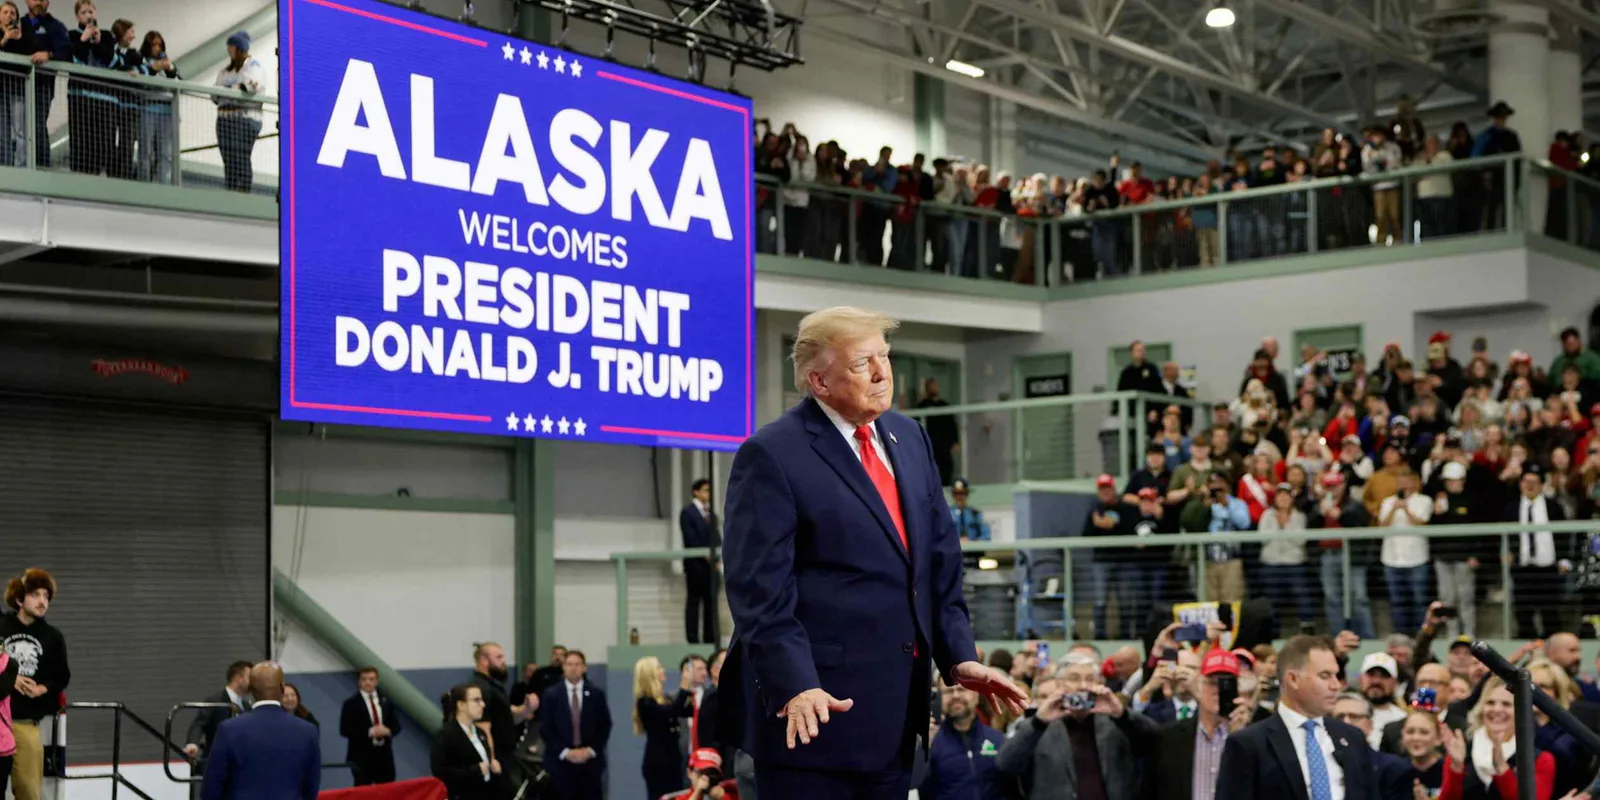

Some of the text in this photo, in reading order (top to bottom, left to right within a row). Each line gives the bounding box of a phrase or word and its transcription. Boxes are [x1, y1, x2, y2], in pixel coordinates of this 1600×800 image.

[316, 58, 734, 241] ALASKA
[458, 208, 628, 269] WELCOMES
[382, 248, 690, 348] PRESIDENT
[335, 315, 724, 403] DONALD J. TRUMP
